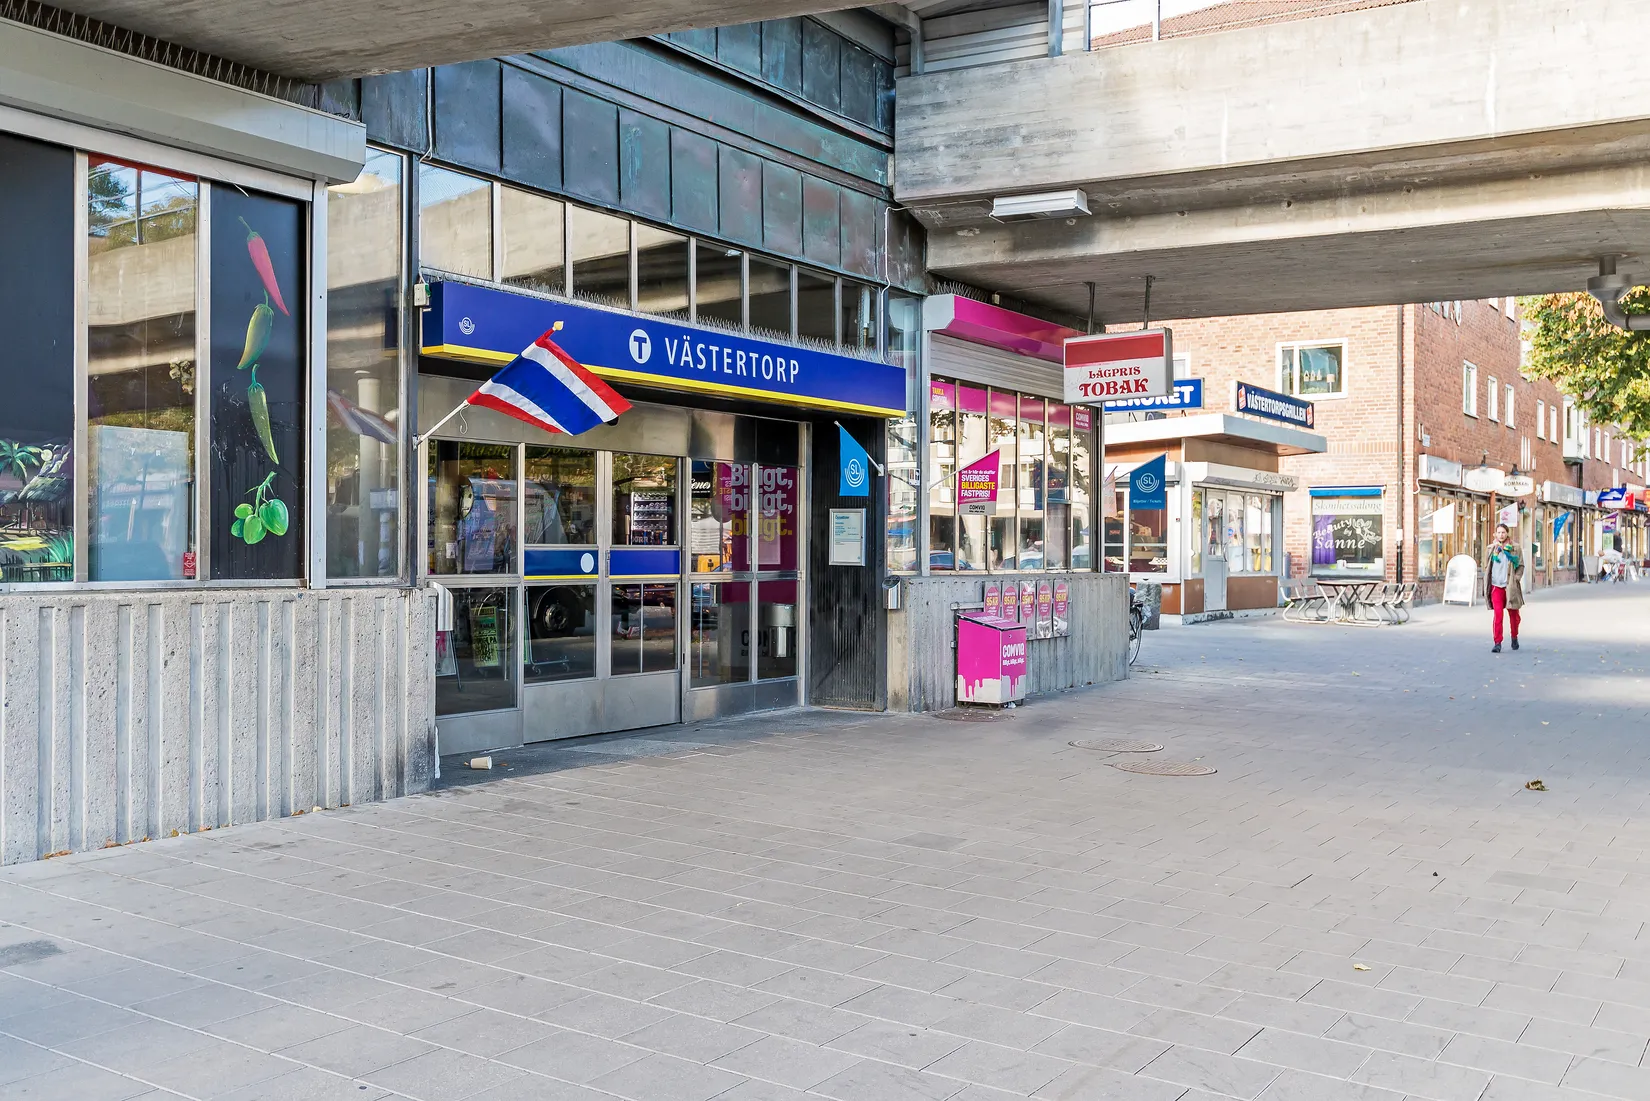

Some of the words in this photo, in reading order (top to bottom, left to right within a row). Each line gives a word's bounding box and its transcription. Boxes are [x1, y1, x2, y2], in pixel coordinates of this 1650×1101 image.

[664, 334, 800, 384] VÄSTERTORP
[1088, 365, 1141, 380] LÅGPRIS
[1078, 377, 1149, 397] TOBAK
[961, 474, 990, 482] SVERIGES
[961, 482, 996, 490] BILLIGASTE
[960, 489, 991, 498] FASTPRIS!
[1315, 537, 1366, 549] Sanne
[1002, 642, 1025, 658] COMVIQ
